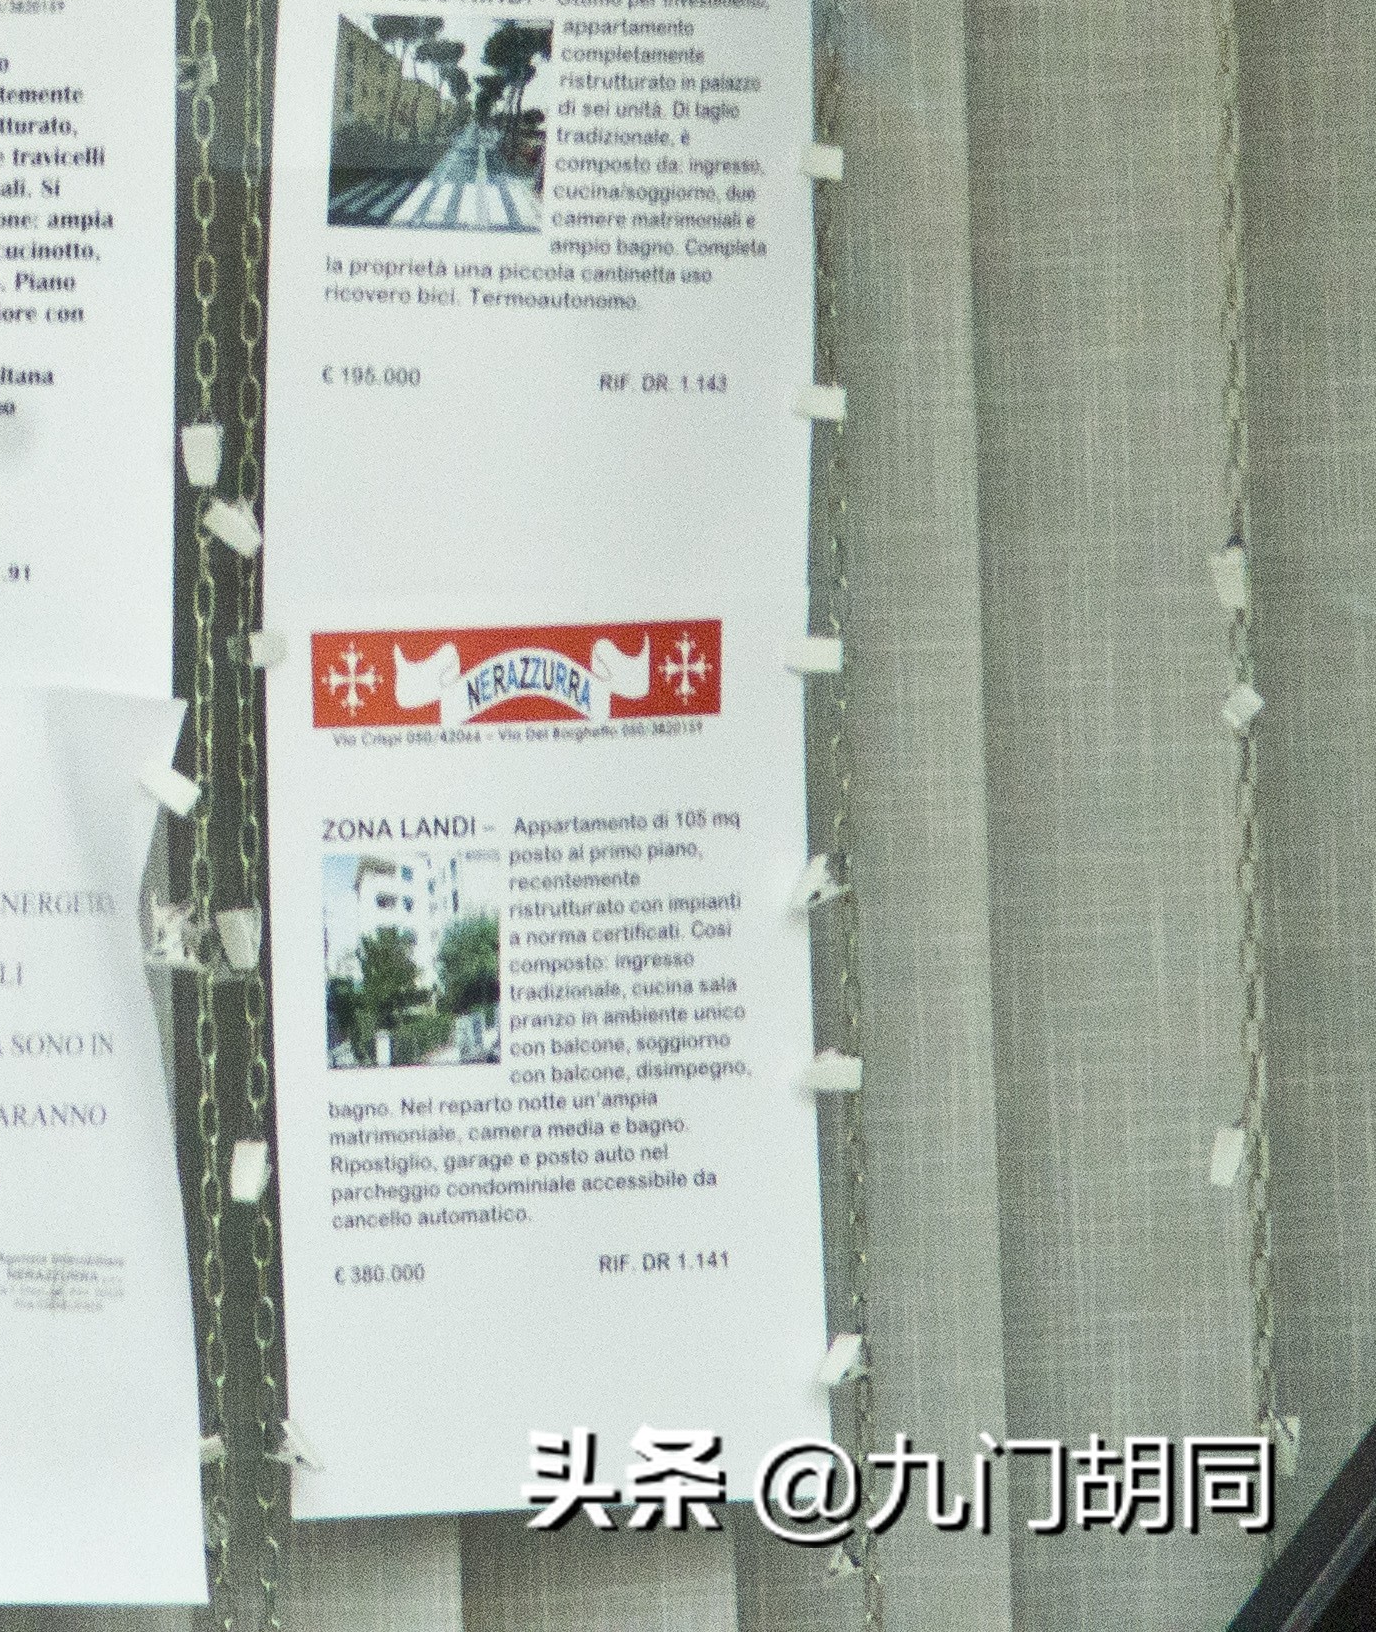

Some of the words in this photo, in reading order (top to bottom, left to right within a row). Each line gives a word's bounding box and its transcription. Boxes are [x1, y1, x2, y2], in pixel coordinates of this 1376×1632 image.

[563, 17, 696, 38] appartamento
[560, 45, 706, 66] completamente
[11, 146, 105, 167] travicelli
[46, 211, 114, 233] ampia
[14, 271, 77, 292] Piano
[44, 307, 85, 324] con
[320, 364, 333, 384] €
[341, 365, 422, 387] 195.000
[467, 655, 592, 711] NERAZZURRA
[322, 817, 394, 841] ZONA
[399, 814, 477, 841] LANDI
[514, 814, 650, 838] Appartamento
[507, 845, 564, 867] posto
[567, 844, 585, 862] al
[588, 843, 643, 865] primo
[646, 841, 703, 862] piano,
[508, 869, 641, 891] recentemente
[508, 898, 626, 919] ristrutturato
[628, 898, 664, 915] con
[667, 892, 742, 915] impianti
[10, 1033, 84, 1057] SONO
[91, 1033, 115, 1058] IN
[331, 1209, 412, 1230] cancello
[417, 1206, 532, 1226] automatico.
[598, 1253, 633, 1273] RIF.
[641, 1251, 671, 1273] DR
[677, 1250, 730, 1269] 1.141
[332, 1266, 346, 1285] €
[351, 1262, 426, 1285] 380.000
